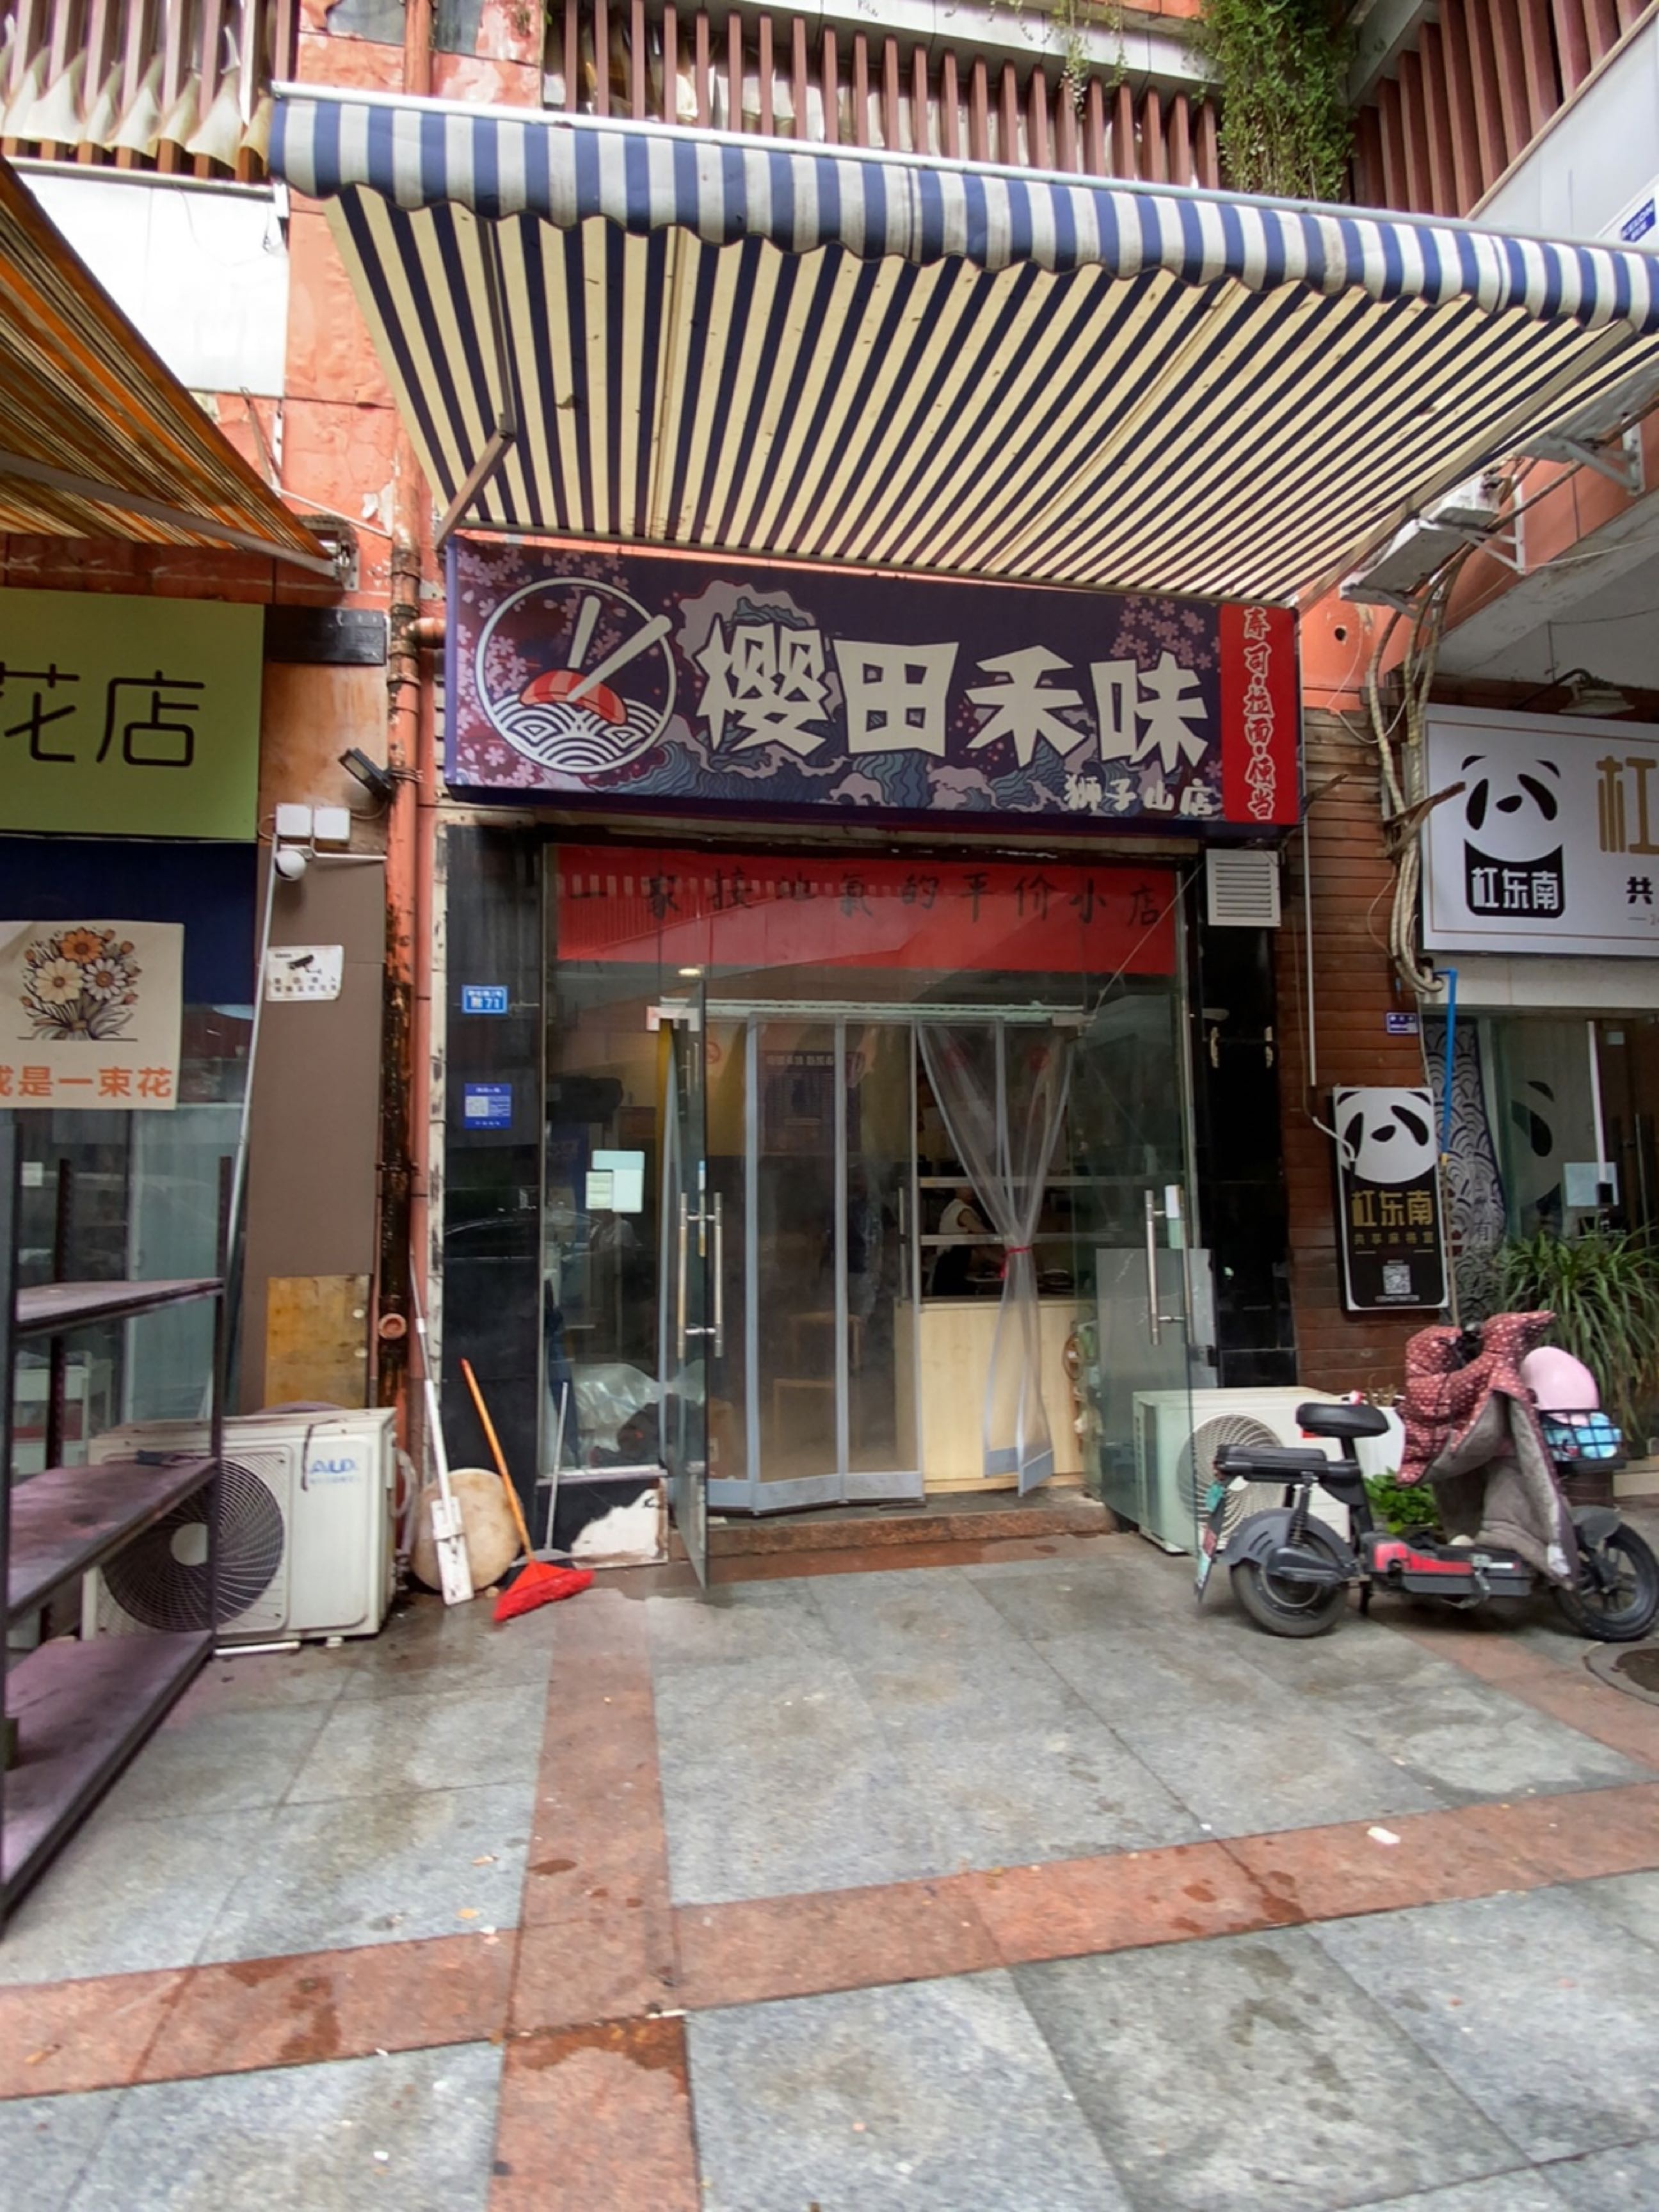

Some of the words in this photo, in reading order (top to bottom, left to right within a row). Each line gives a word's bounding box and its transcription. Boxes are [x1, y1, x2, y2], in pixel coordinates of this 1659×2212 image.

[0, 662, 205, 767] 花店
[695, 616, 1209, 773] 樱田禾味
[1064, 774, 1214, 816] 狮子山店
[1626, 876, 1653, 904] 共
